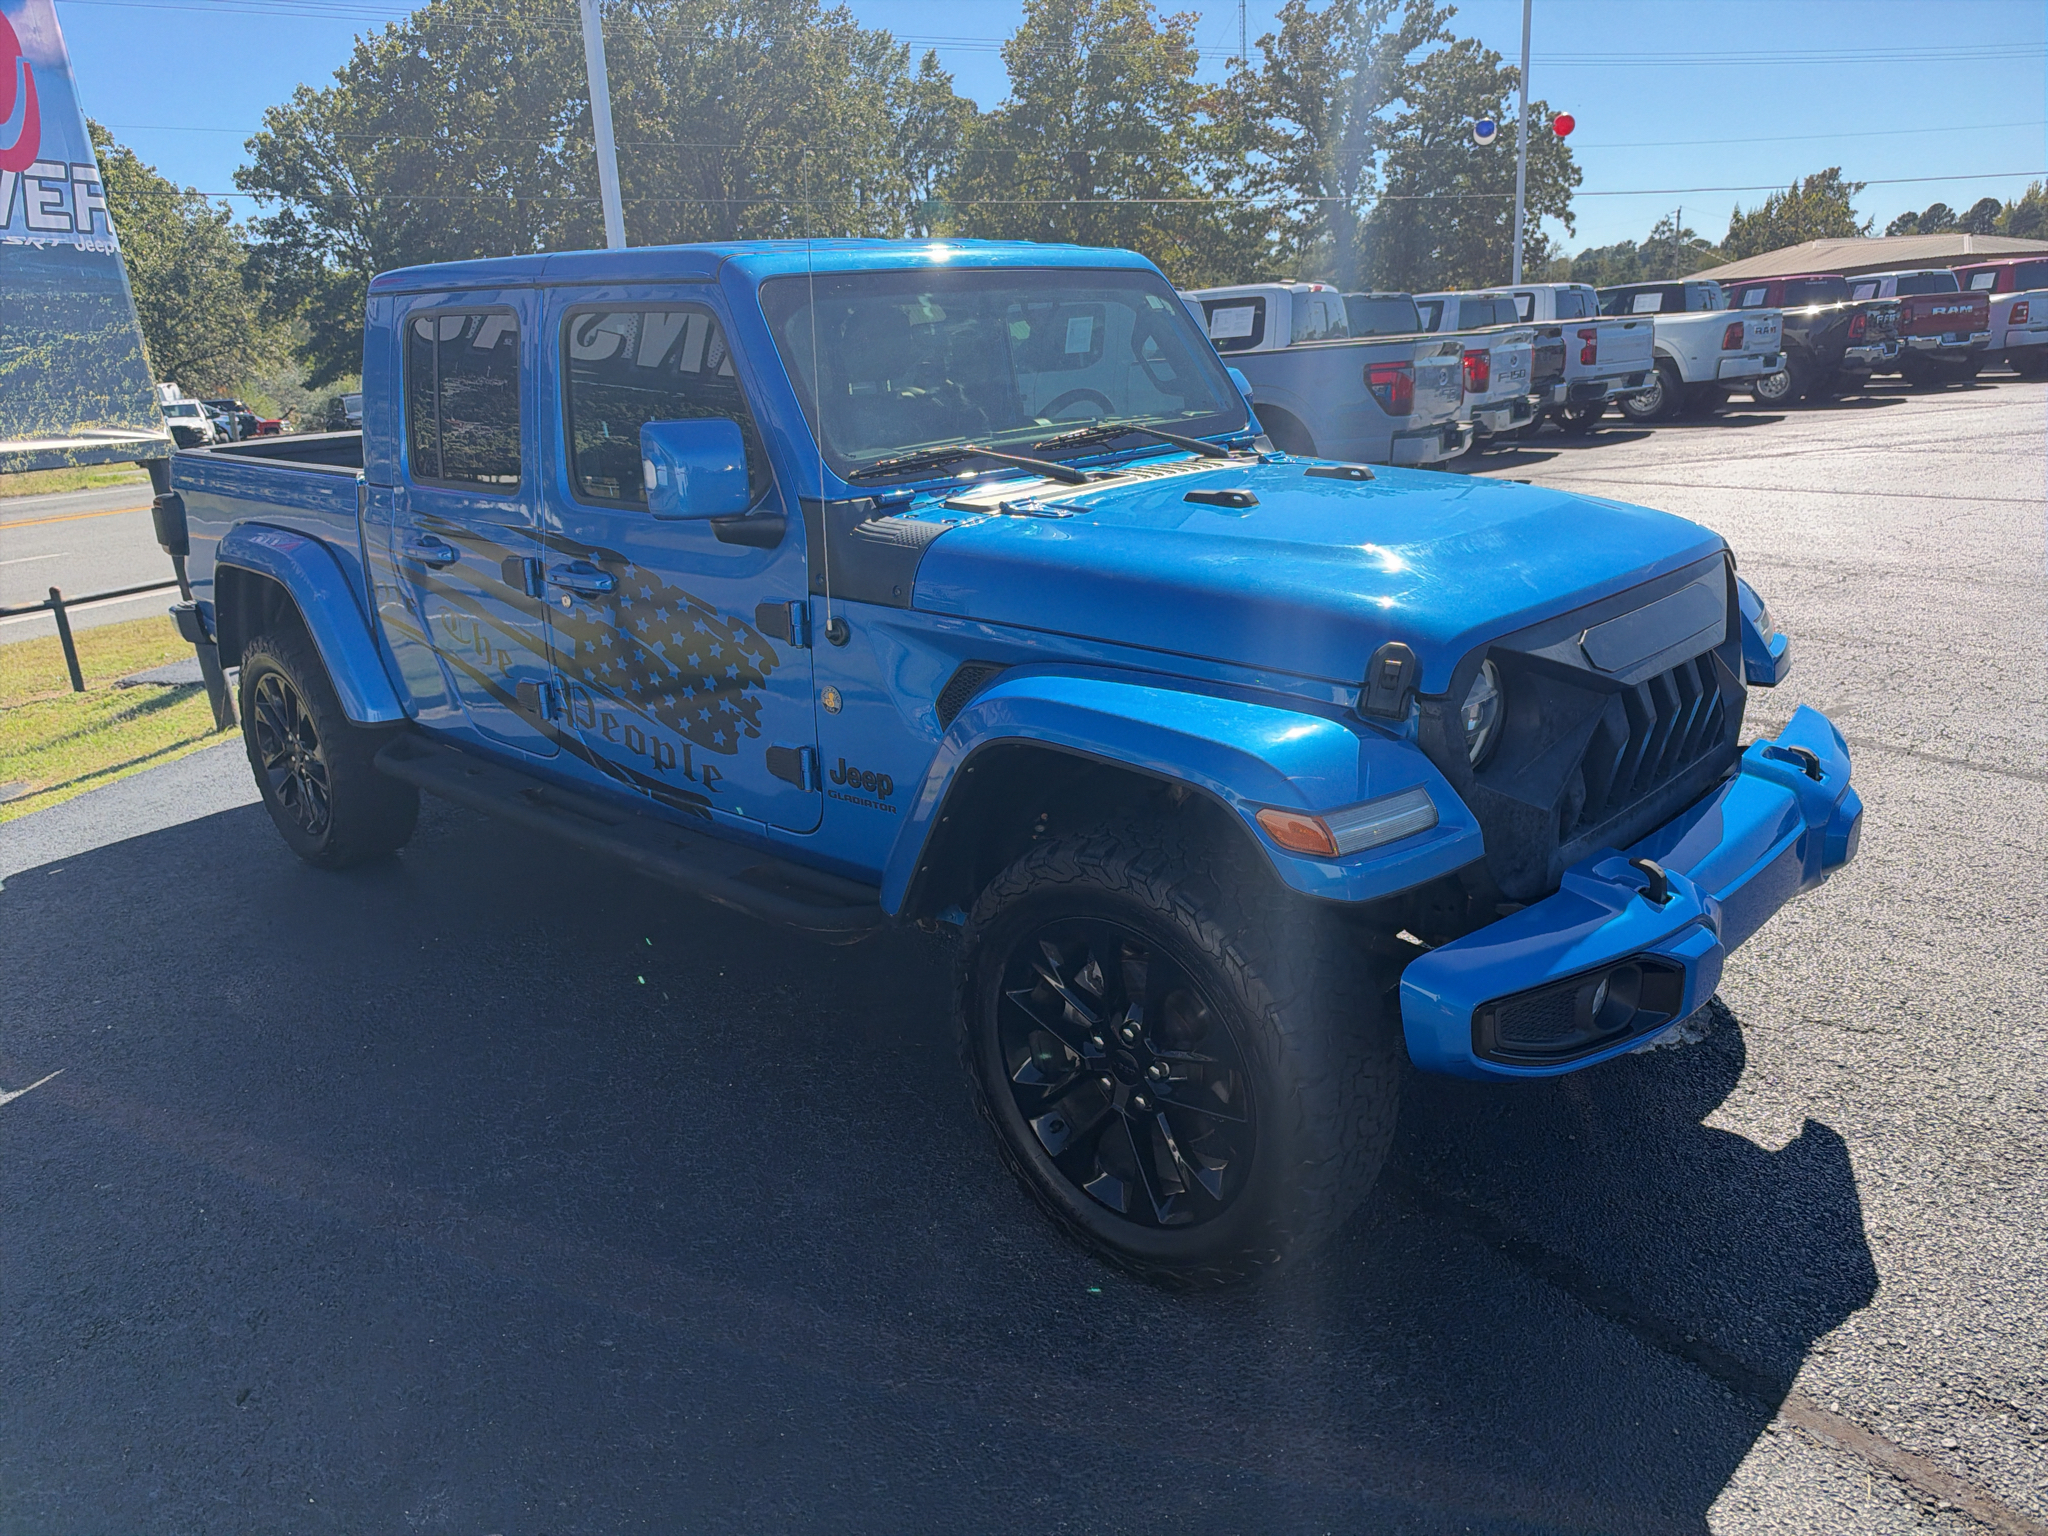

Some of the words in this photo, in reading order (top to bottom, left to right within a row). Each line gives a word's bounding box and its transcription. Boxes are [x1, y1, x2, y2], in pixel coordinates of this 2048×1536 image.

[2, 236, 66, 250] SRT
[74, 236, 114, 256] Jeep
[1932, 305, 1974, 316] RAM
[1754, 326, 1777, 335] RAM
[1497, 369, 1526, 383] F-150
[438, 605, 514, 679] The
[554, 673, 724, 793] People
[828, 757, 894, 801] Jeep
[827, 789, 898, 815] GLADIATOR
